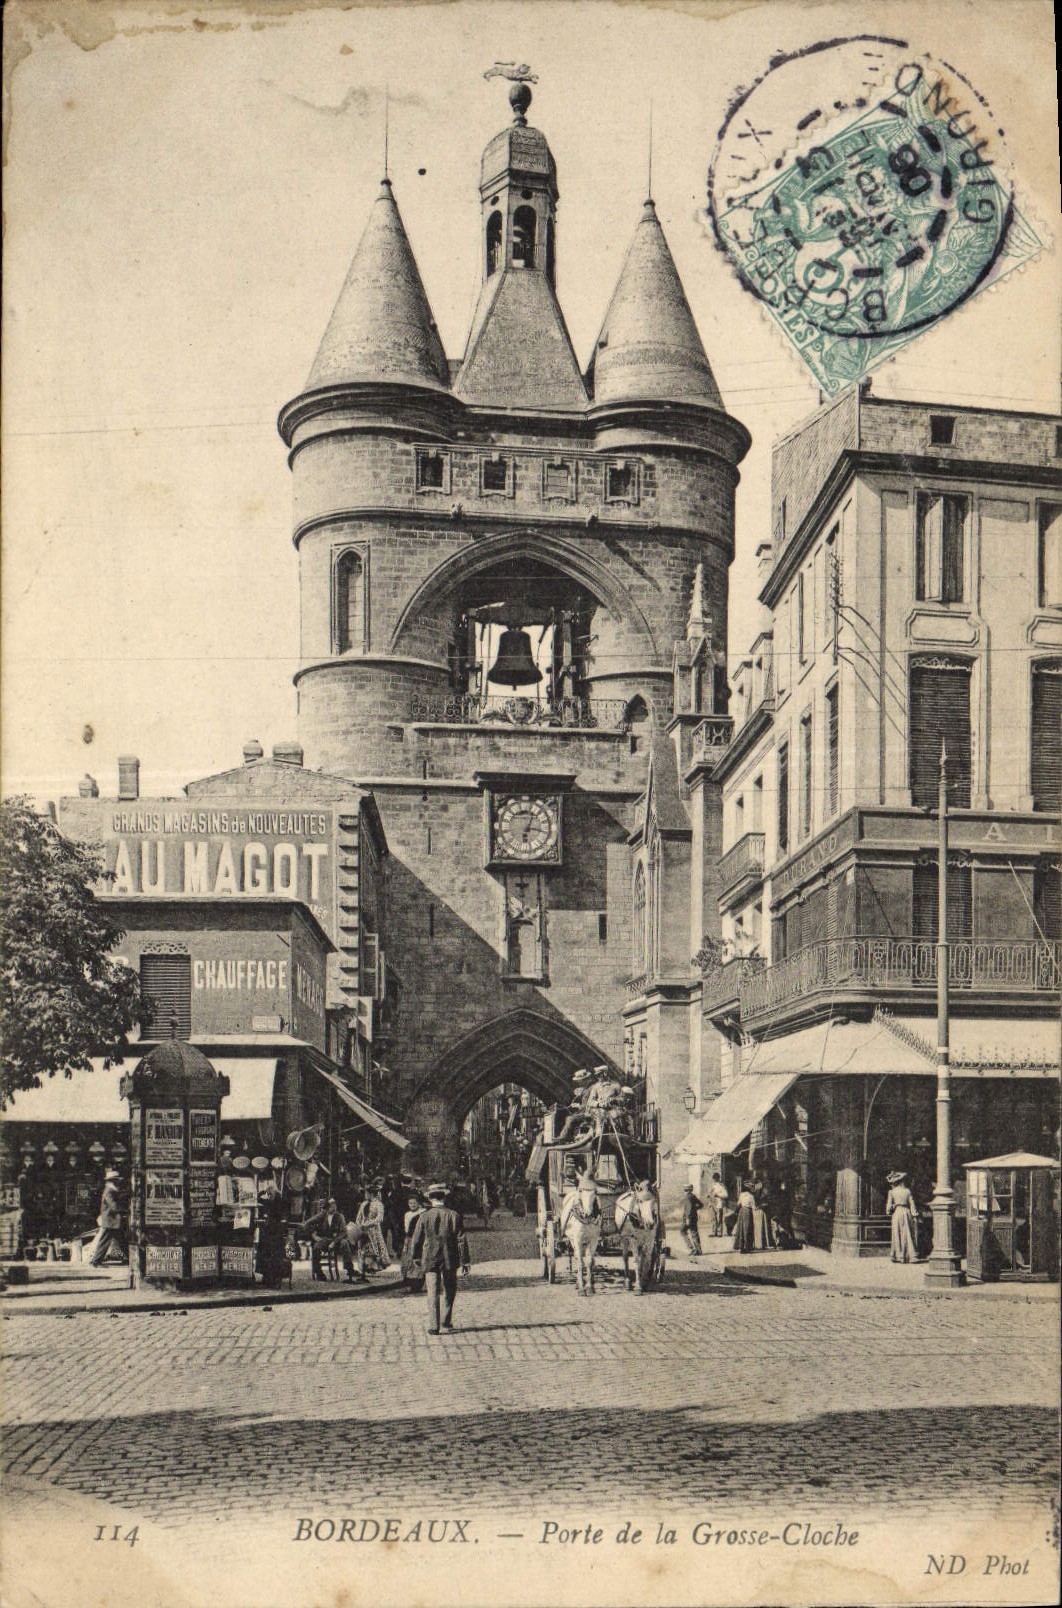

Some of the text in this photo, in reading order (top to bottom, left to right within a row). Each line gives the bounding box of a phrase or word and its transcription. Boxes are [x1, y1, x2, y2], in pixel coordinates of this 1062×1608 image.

[748, 259, 816, 344] POSTES
[112, 811, 159, 833] GRANDS
[163, 811, 229, 833] MAGASINS
[231, 815, 246, 833] de
[111, 840, 329, 900] AU MAGOT
[193, 959, 288, 989] CHAUFFAGE
